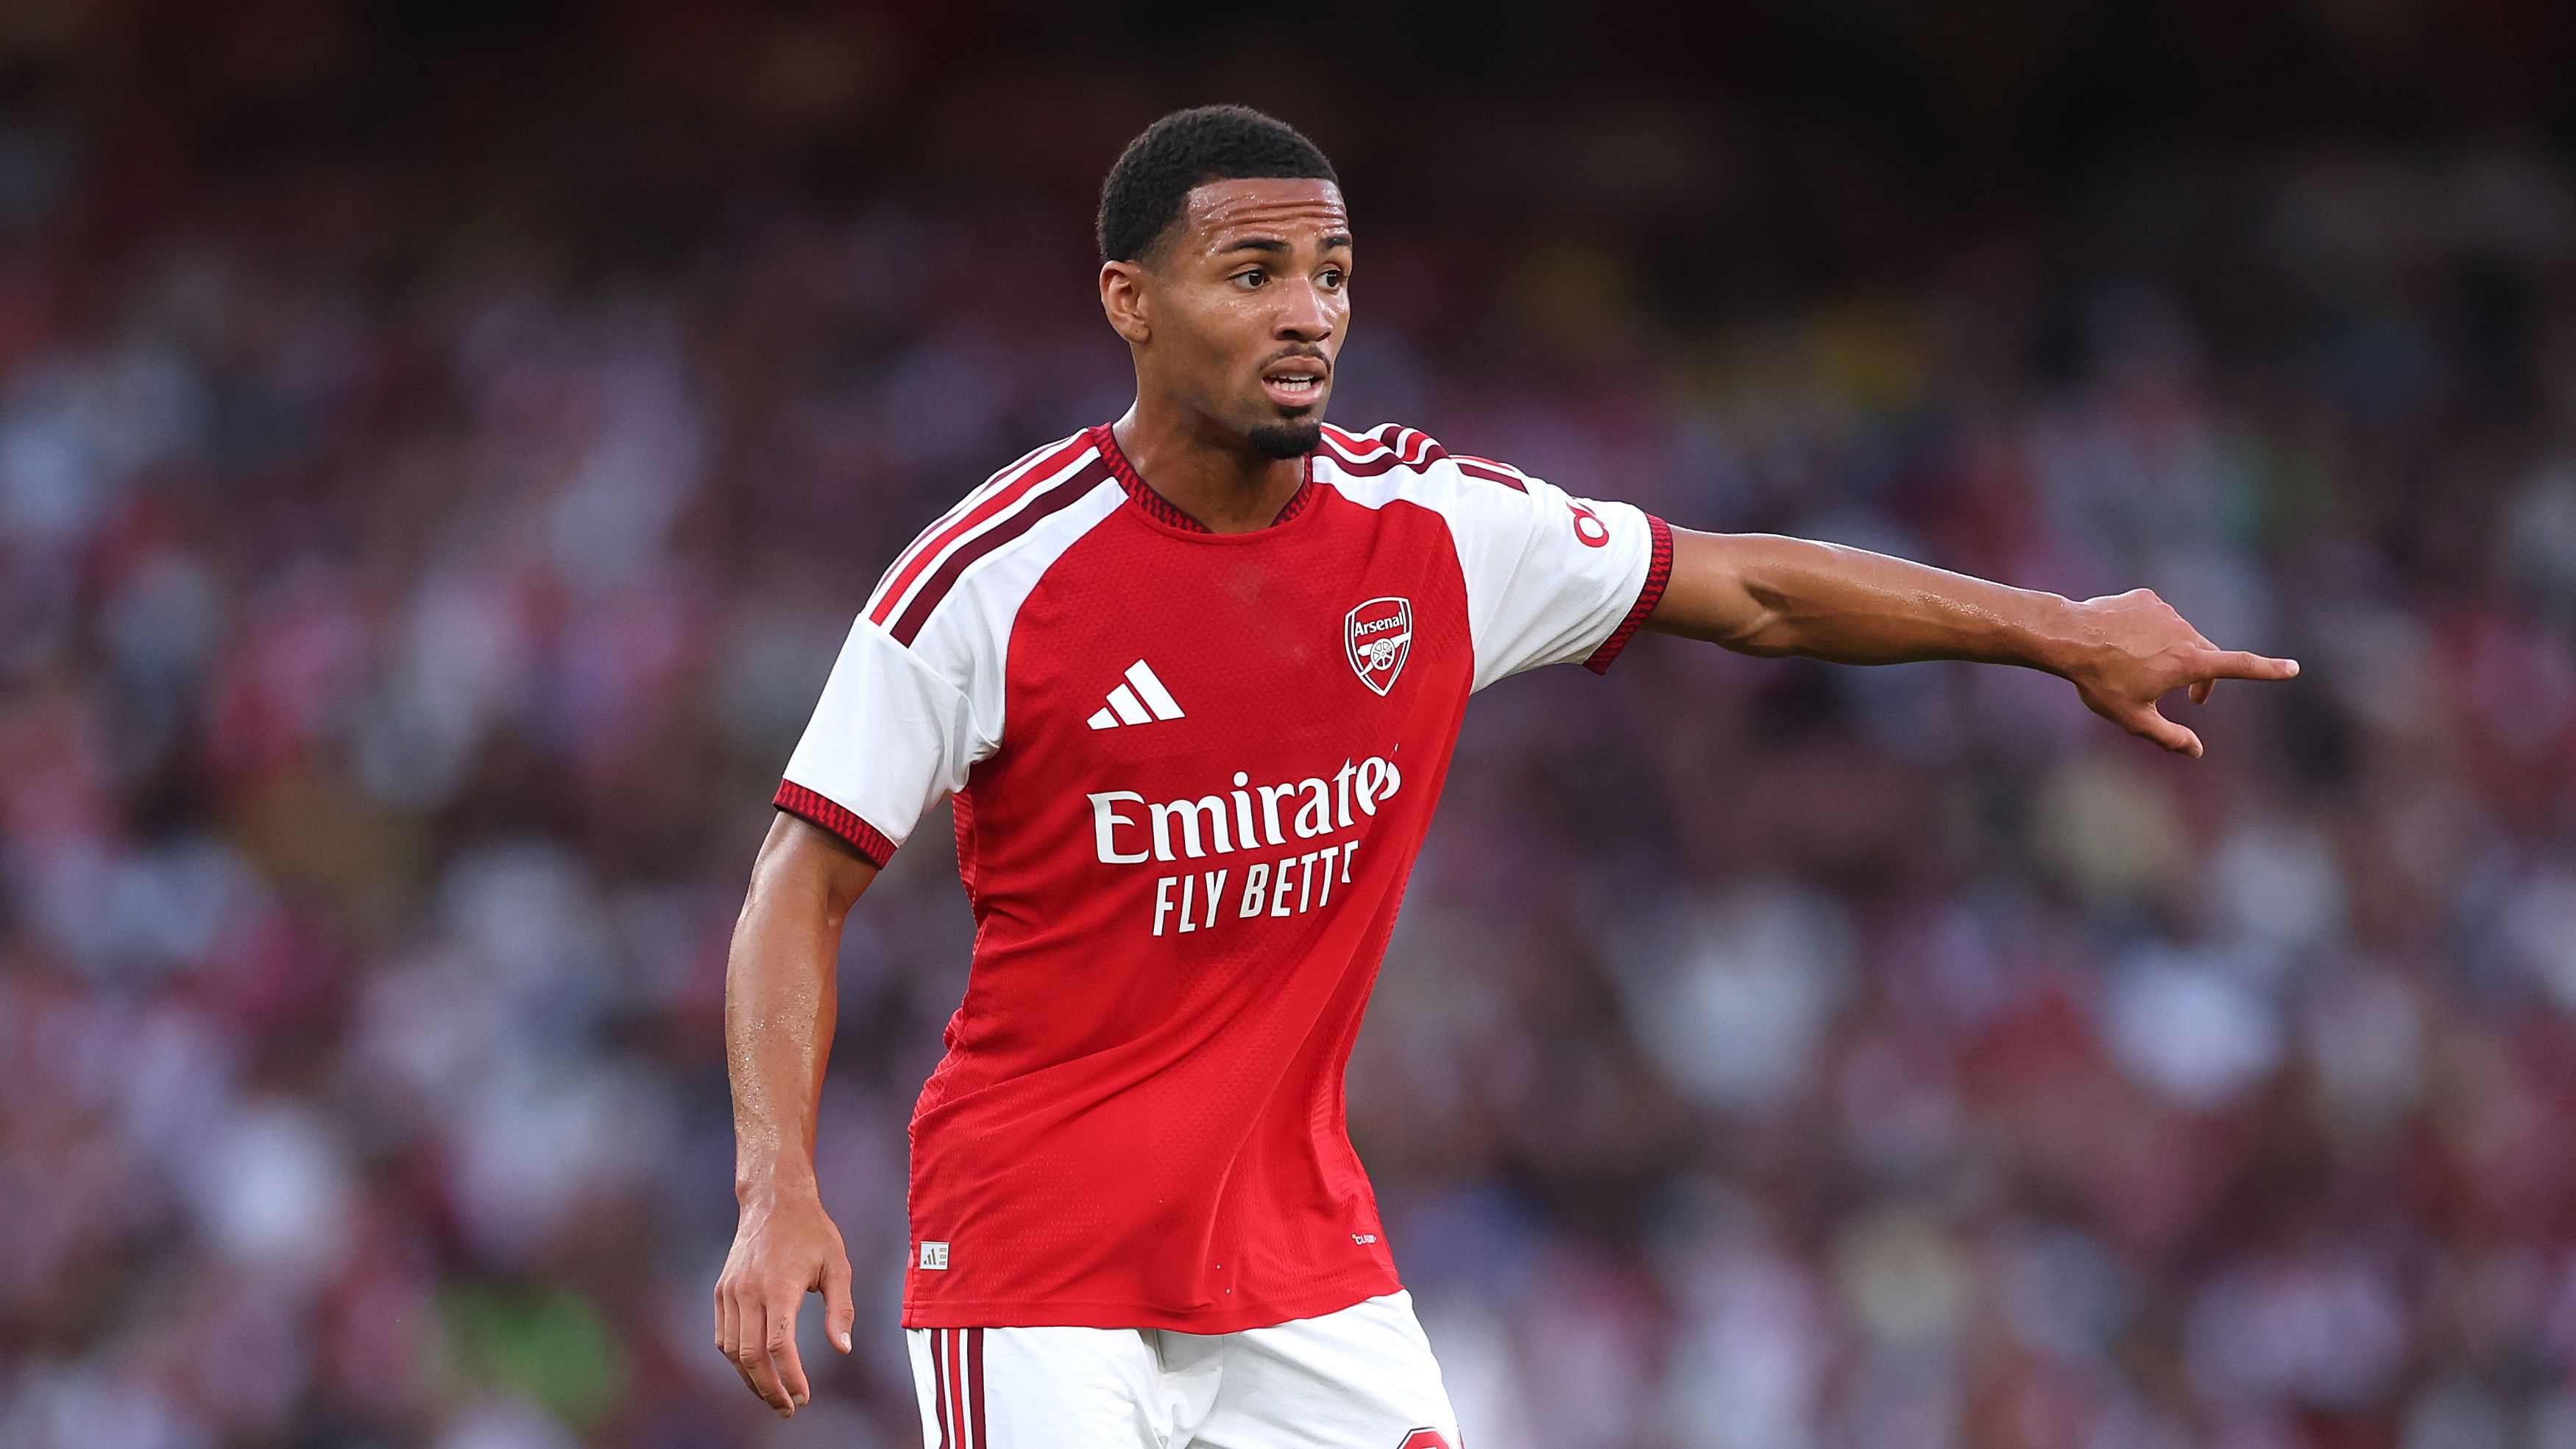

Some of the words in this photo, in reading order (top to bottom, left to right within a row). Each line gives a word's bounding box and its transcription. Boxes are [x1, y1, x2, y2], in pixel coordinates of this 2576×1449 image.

[1354, 611, 1404, 637] Arsenal
[1153, 869, 1228, 936] FLY
[1239, 840, 1359, 918] BETT
